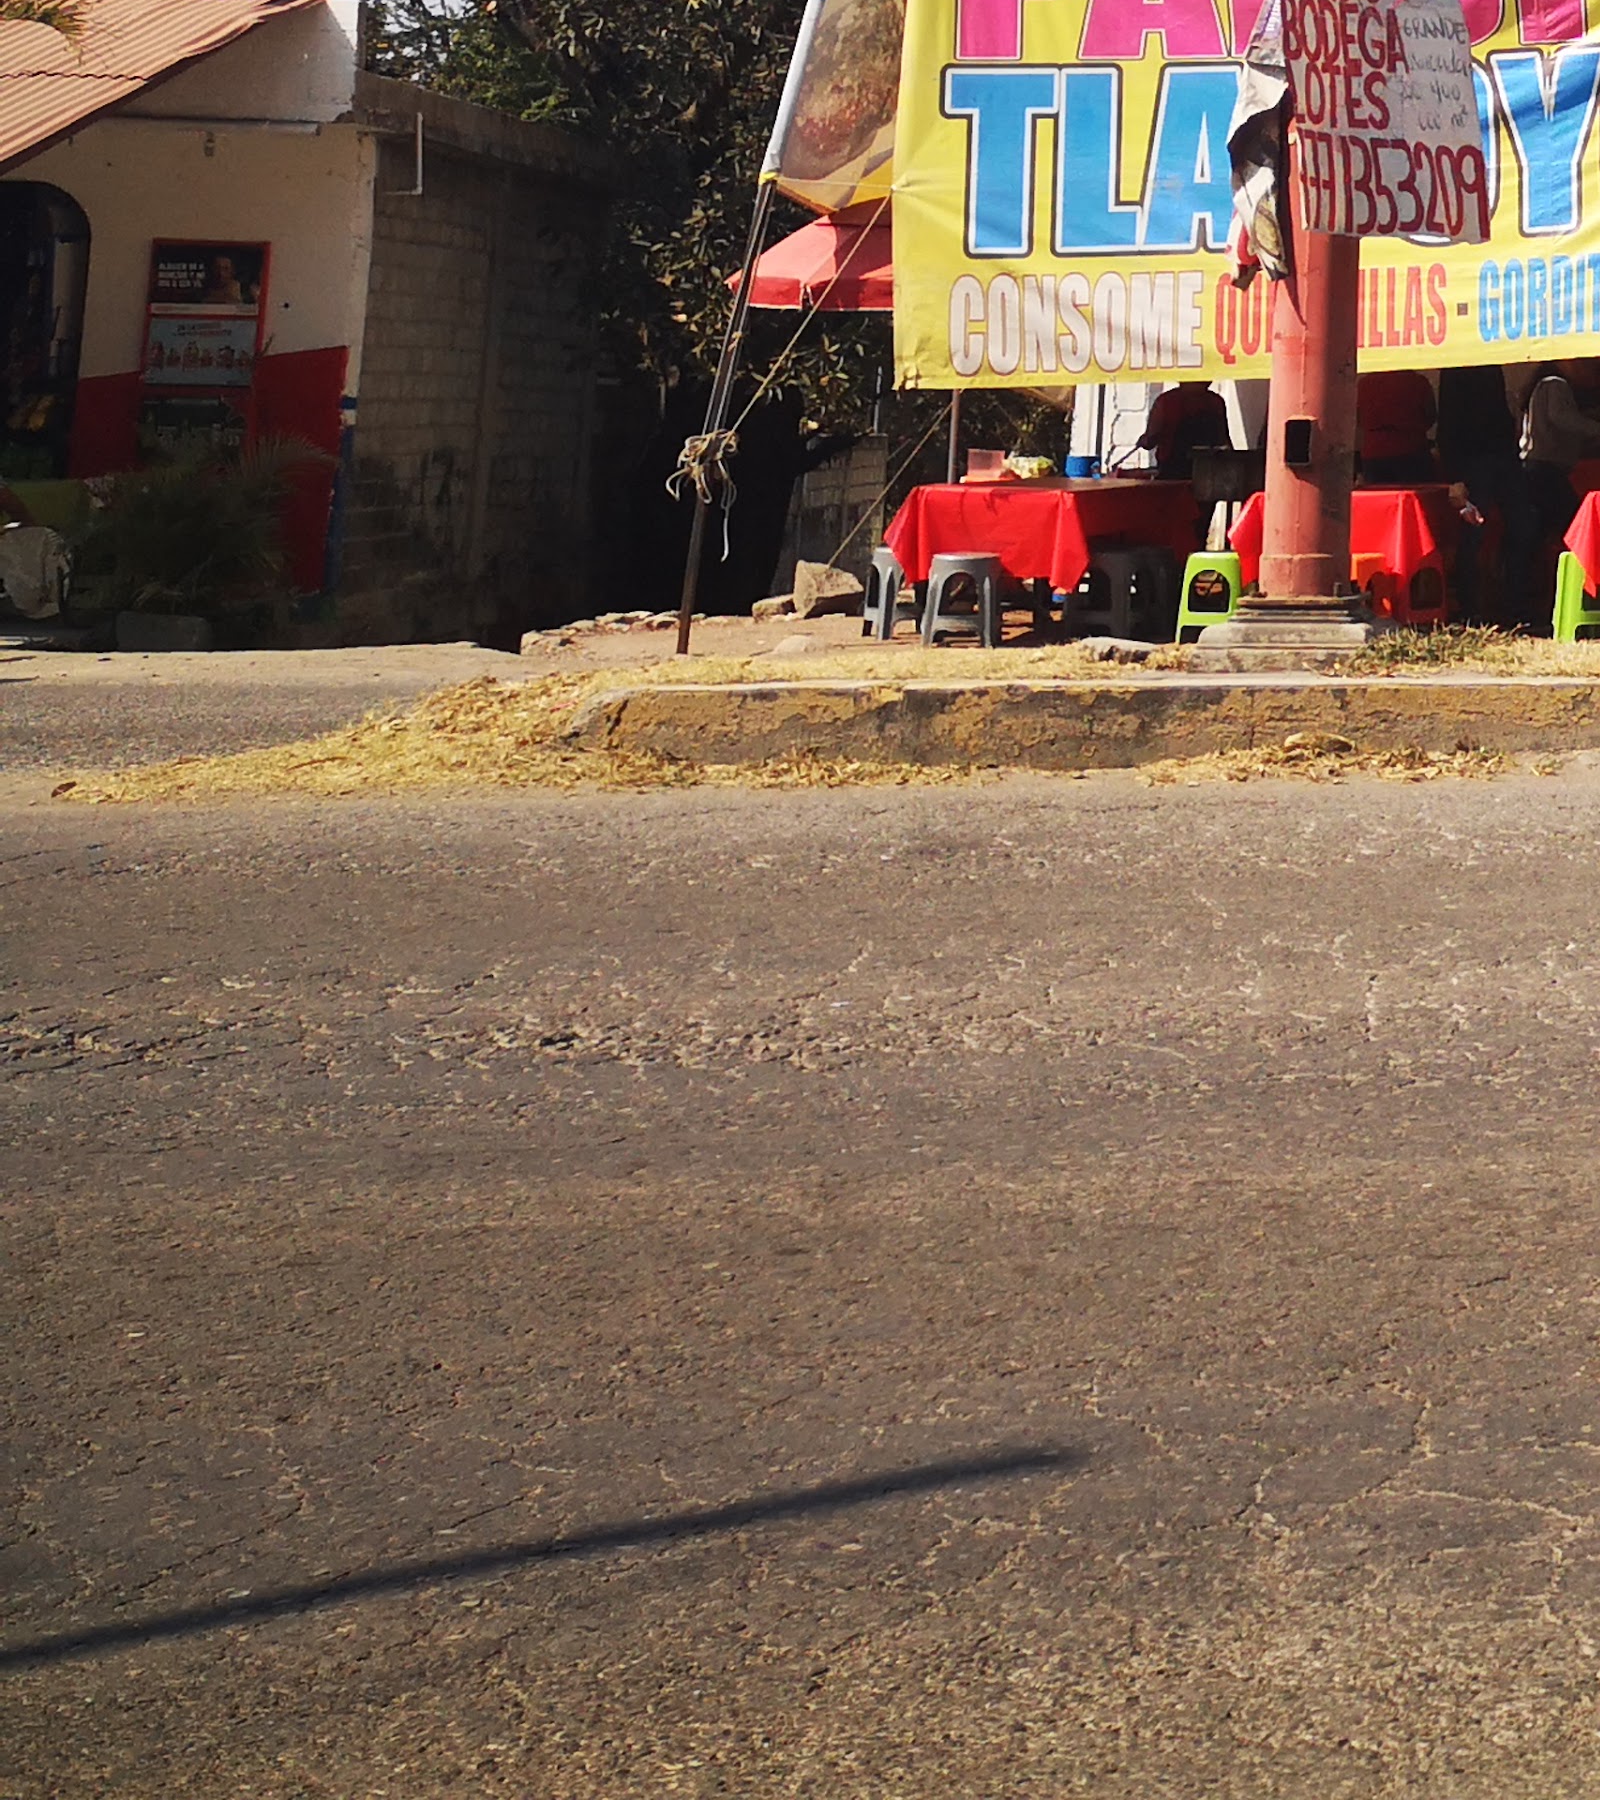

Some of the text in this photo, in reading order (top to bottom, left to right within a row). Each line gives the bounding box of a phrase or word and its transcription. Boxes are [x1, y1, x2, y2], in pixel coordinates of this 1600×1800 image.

[1285, 59, 1390, 130] LOTES
[949, 270, 1204, 378] CONSOME
[1215, 263, 1447, 365] QUILLAS
